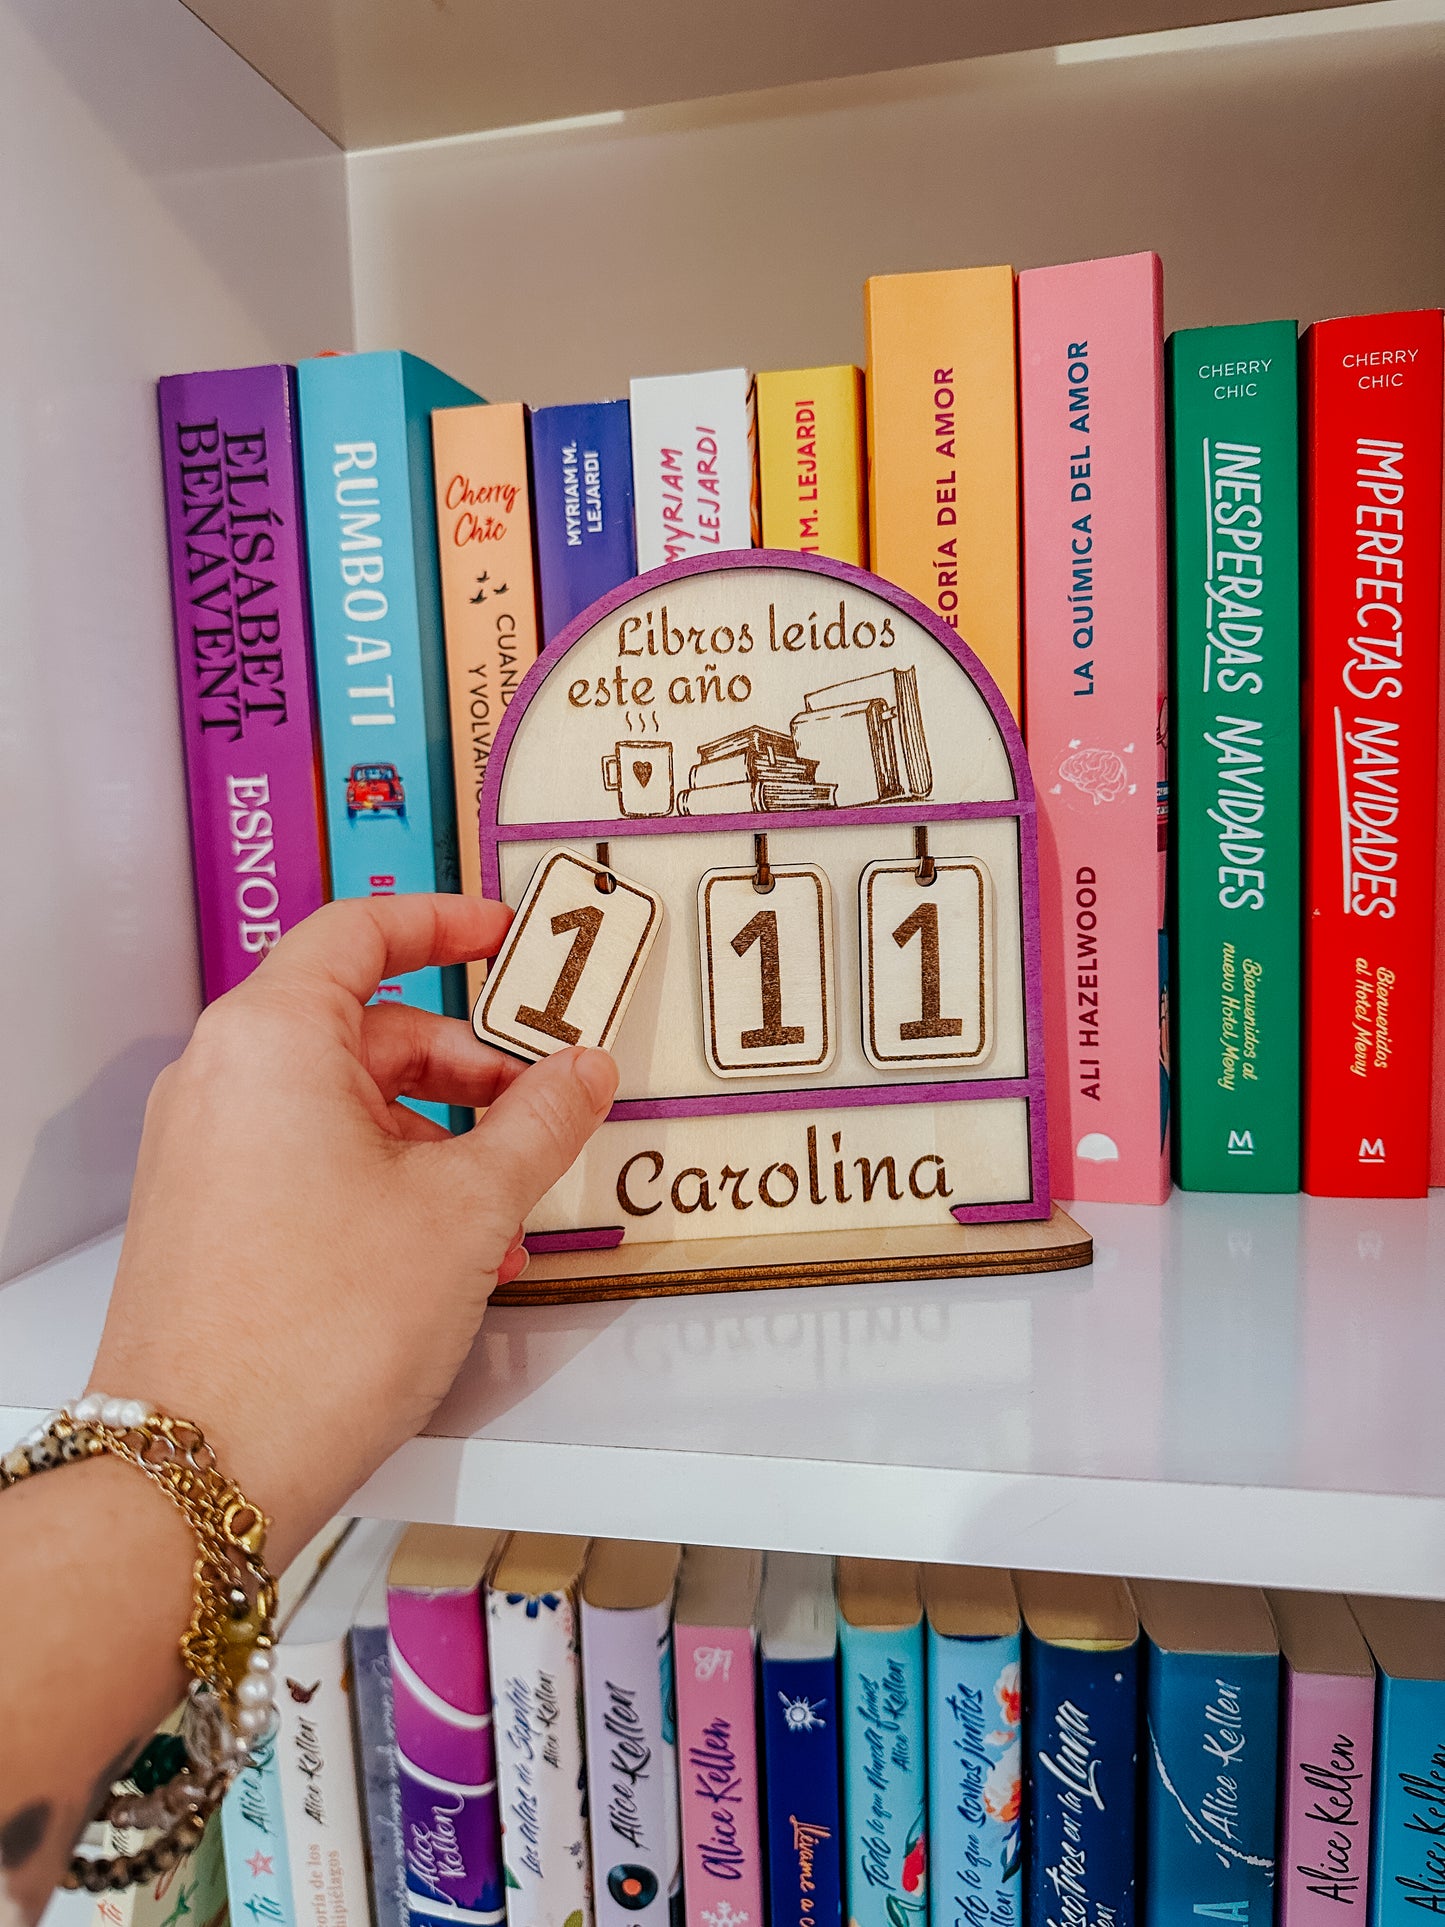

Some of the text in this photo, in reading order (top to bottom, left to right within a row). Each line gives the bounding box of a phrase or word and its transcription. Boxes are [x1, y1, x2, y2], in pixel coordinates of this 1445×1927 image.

[1198, 359, 1273, 380] CHERRY
[1213, 382, 1258, 401] CHIC
[1342, 349, 1420, 369] CHERRY
[1358, 373, 1404, 390] CHIC
[445, 474, 521, 514] Cherry
[562, 440, 582, 546] MYRIAM M.
[583, 450, 602, 533] LEJARDI
[696, 426, 720, 545] LEJARDI
[795, 400, 817, 501] LEJARDI
[932, 367, 959, 629] EORÍA DEL AMOR
[454, 512, 507, 547] Chic
[799, 509, 819, 538] M.
[1068, 340, 1095, 697] LA QUÍMICA DEL AMOR
[177, 418, 244, 742] BENAVENT
[224, 427, 288, 727] ELÍSABET
[333, 441, 397, 726] RUMBO A TI
[618, 600, 897, 657] Libros leídos
[496, 614, 519, 707] CUAND
[568, 663, 752, 708] este año
[1203, 441, 1265, 912] INESPERADAS NAVIDADES
[1342, 437, 1404, 920] IMPERFECTAS NAVIDADES
[468, 664, 492, 820] Y VOLVAM
[226, 774, 282, 954] ESNOB
[514, 902, 963, 1050] 1 1 1
[1076, 865, 1100, 1102] ALI HAZELWOOD
[1218, 942, 1241, 1092] nuevo Hotel Merry
[1242, 958, 1263, 1081] Bienvenidos al
[1350, 957, 1374, 1078] al Hotel Merry
[1374, 966, 1395, 1069] Bienvenidos
[615, 1125, 955, 1216] Carolina
[535, 1669, 560, 1728] Kellen
[882, 1658, 911, 1774] Alice Kellen
[241, 1779, 278, 1838] Alice
[295, 1715, 329, 1828] Alice Kellen
[604, 1680, 651, 1851] Alice Kellen
[689, 1717, 743, 1803] Kellen
[1039, 1700, 1105, 1811] Luna
[1199, 1678, 1246, 1844] Alice Kellen
[406, 1821, 456, 1906] Alice
[431, 1794, 467, 1878] Kellen
[861, 1836, 896, 1891] Todo
[1296, 1734, 1364, 1905] Alice Kellen
